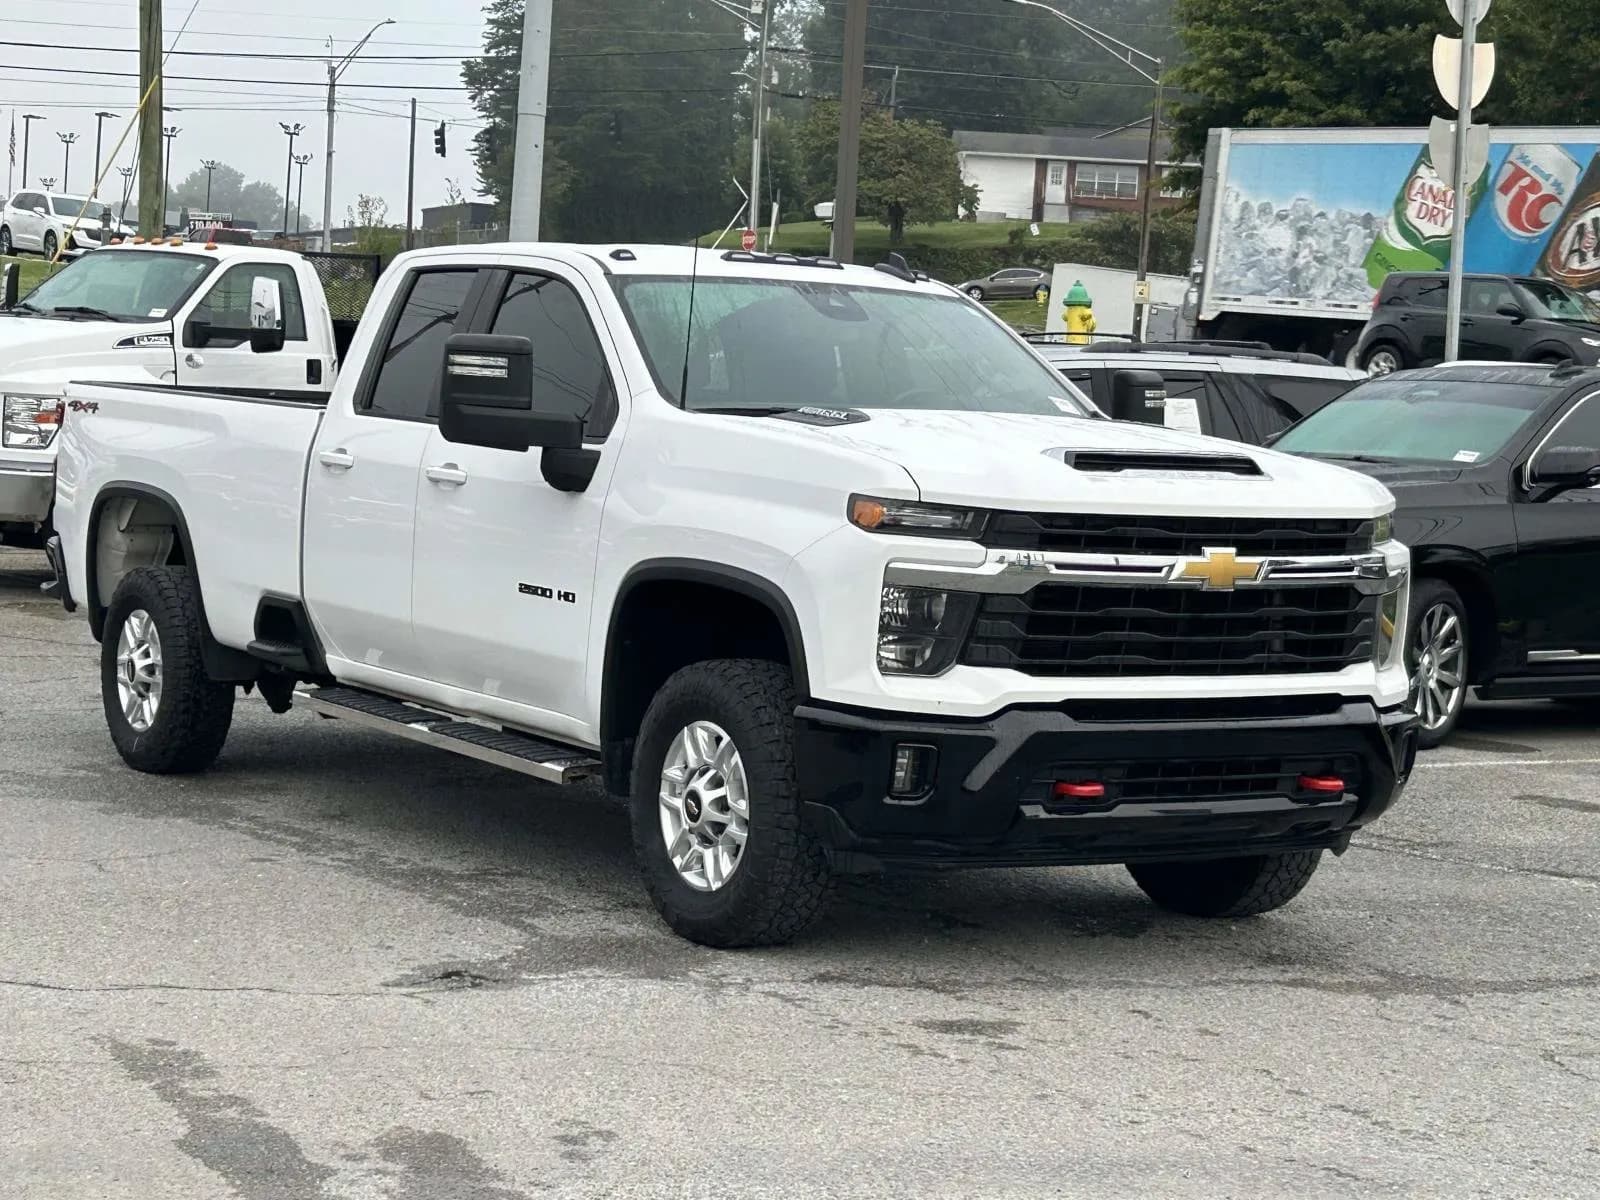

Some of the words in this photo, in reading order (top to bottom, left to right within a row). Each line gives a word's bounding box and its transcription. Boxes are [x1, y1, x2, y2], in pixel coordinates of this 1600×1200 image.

[1406, 175, 1455, 211] CANA
[1497, 160, 1563, 234] RC
[1416, 201, 1452, 227] DRY
[518, 582, 553, 599] 2500
[557, 589, 576, 603] HD
